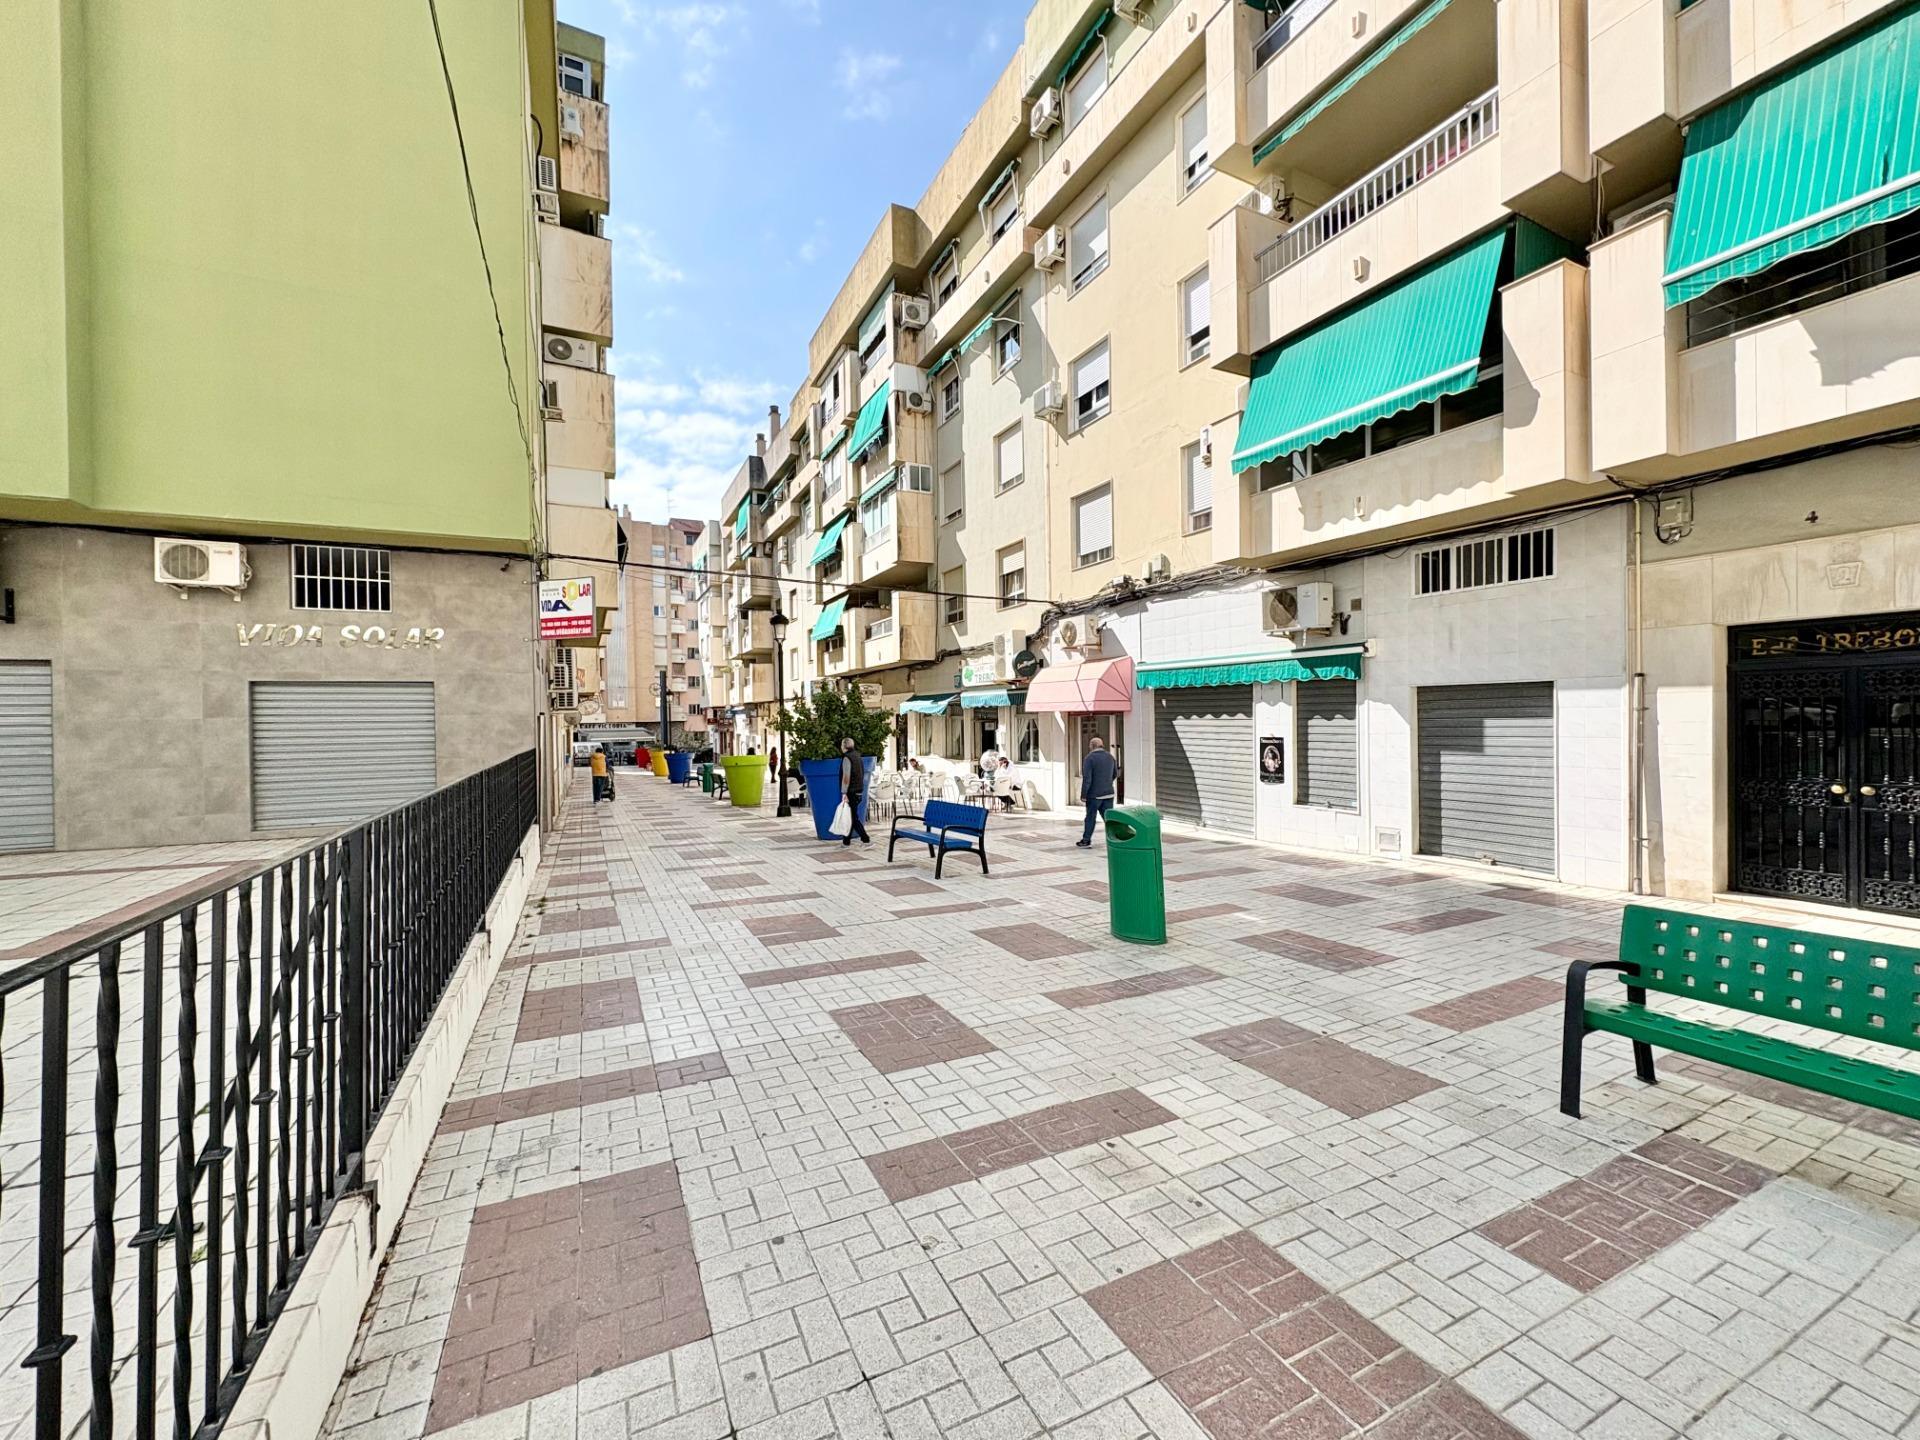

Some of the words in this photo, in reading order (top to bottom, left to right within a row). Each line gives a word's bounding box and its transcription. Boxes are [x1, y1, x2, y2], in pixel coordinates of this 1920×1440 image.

[561, 581, 591, 600] SOLAR
[541, 599, 573, 612] VIDA
[236, 623, 323, 647] VIDA
[339, 625, 445, 650] SOLAR
[1816, 628, 1920, 652] TREBO
[974, 672, 996, 684] TREBO
